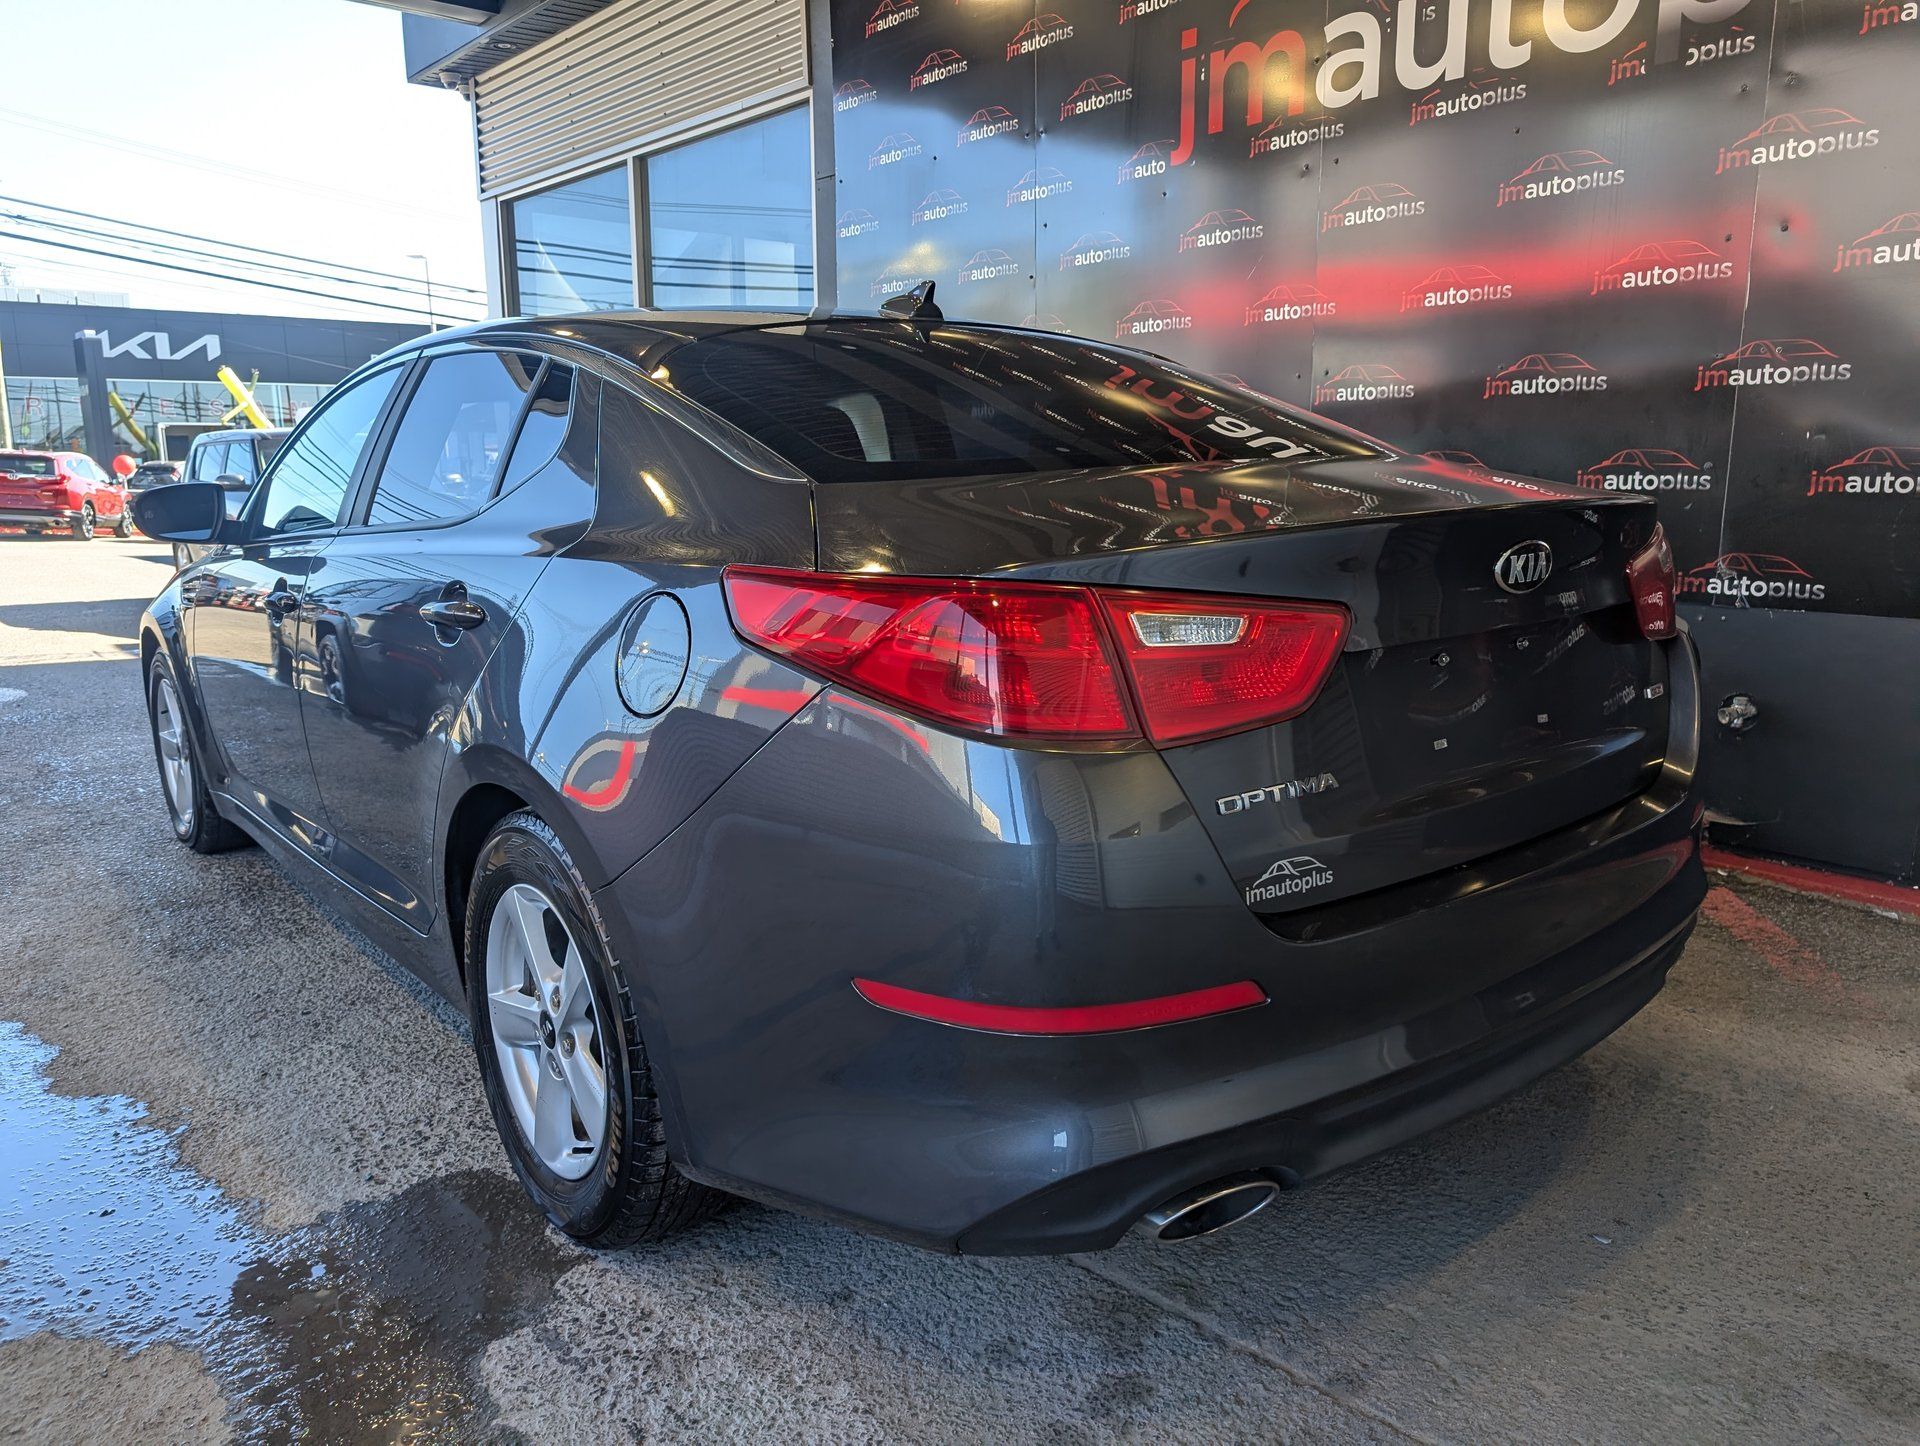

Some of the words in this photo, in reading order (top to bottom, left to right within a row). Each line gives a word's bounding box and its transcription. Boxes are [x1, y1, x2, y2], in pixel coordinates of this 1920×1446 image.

[865, 5, 920, 39] jmautoplus
[1006, 24, 1074, 62] jmautoplus
[910, 60, 968, 92] jmautoplus
[1060, 86, 1133, 122] jmautoplus
[1410, 82, 1527, 126] jmautoplus
[957, 117, 1019, 147] jmautoplus
[1249, 122, 1345, 158] jmautoplus
[1715, 128, 1880, 175] jmautoplus
[1006, 179, 1073, 208] jmautoplus
[1497, 169, 1625, 208] jmautoplus
[912, 202, 969, 226] jmautoplus
[1321, 200, 1425, 233] jmautoplus
[837, 220, 880, 239] autoplus
[1178, 224, 1264, 253] jmautoplus
[1059, 245, 1131, 271] jmautoplus
[958, 262, 1019, 285] jmautoplus
[1591, 259, 1733, 296] jmautoplus
[1400, 283, 1513, 313] jmautoplus
[1115, 314, 1192, 339] jmautoplus
[1245, 301, 1336, 327] jmautoplus
[1483, 374, 1607, 399] jmautoplus
[1694, 361, 1852, 392] jmautoplus
[1314, 383, 1415, 406] jmautoplus
[1576, 469, 1711, 491] jmautoplus
[1508, 550, 1549, 584] KIA
[1672, 571, 1826, 601] jmautoplus
[1216, 772, 1341, 816] OPTIMA
[1246, 868, 1334, 906] jmautoplus
